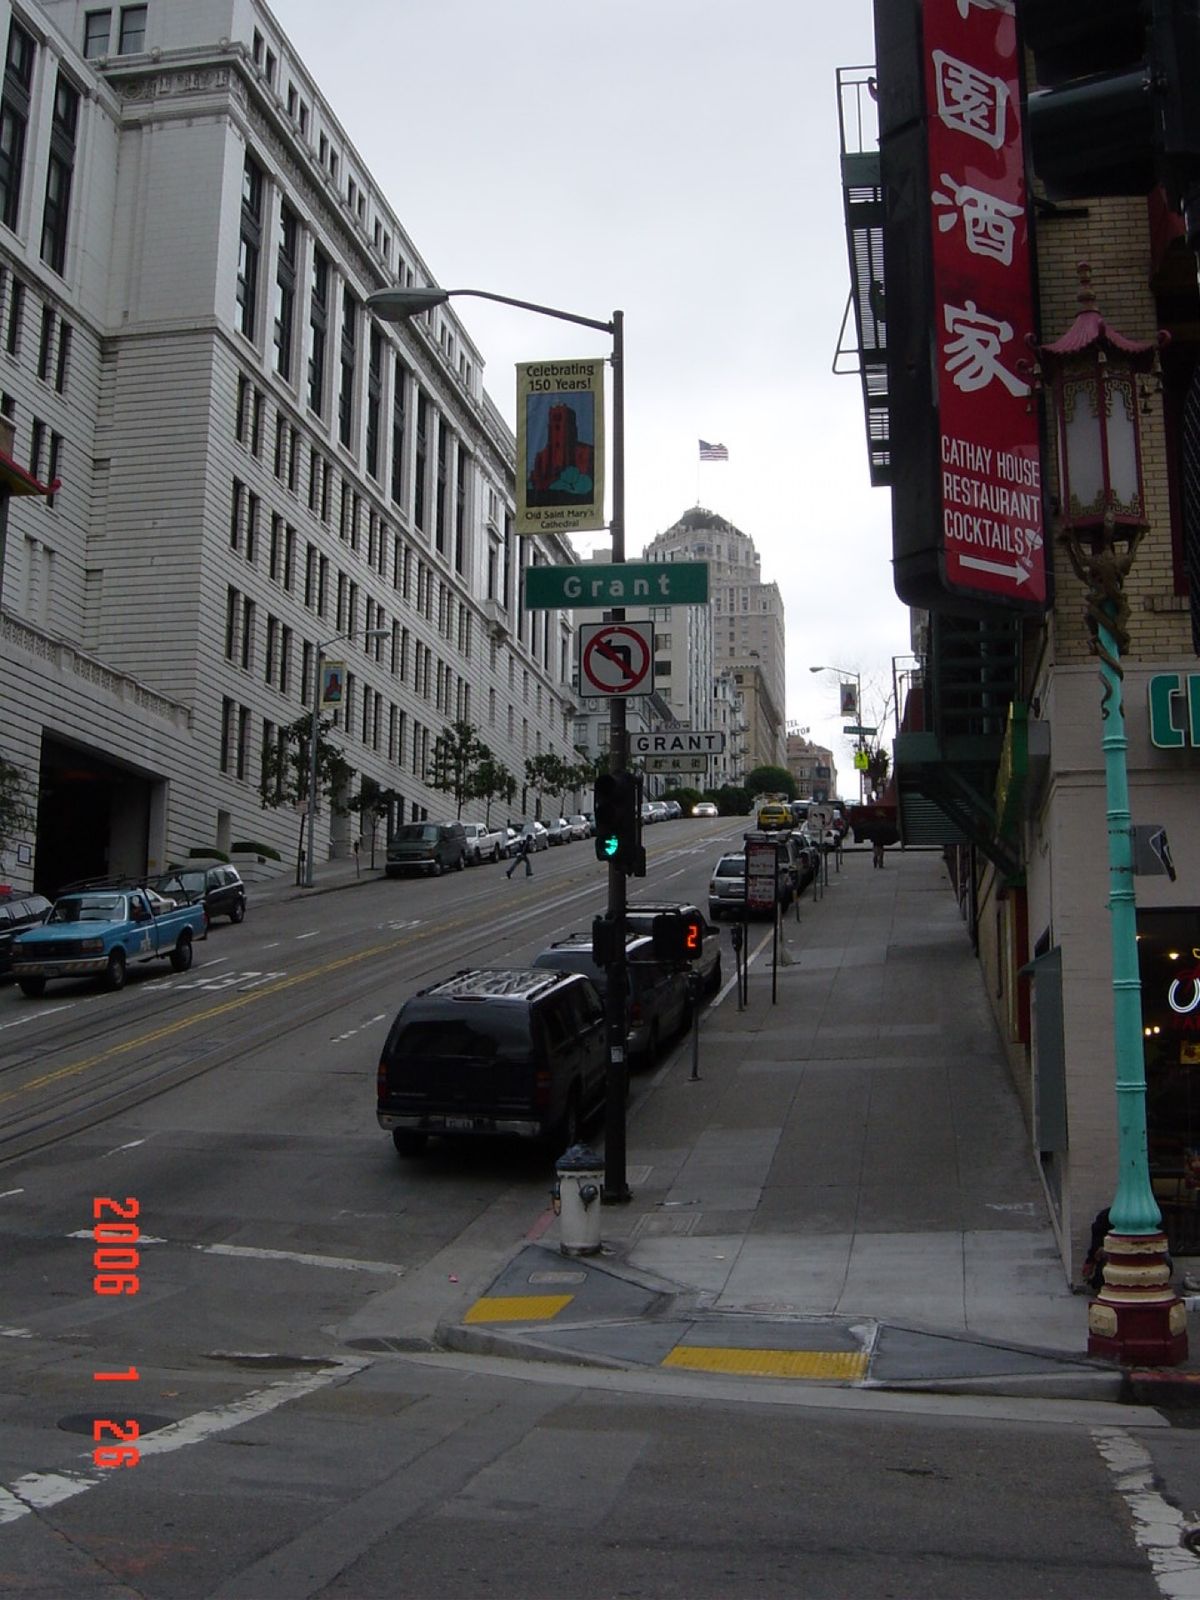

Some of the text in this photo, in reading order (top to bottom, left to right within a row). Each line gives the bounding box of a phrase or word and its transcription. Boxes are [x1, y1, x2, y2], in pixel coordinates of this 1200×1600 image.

[931, 0, 1032, 398] 園酒家
[526, 363, 594, 377] Celebrating
[529, 378, 591, 391] 150 Years!
[941, 435, 1040, 488] CATHAY HOUSE
[943, 472, 1040, 523] RESTAURANT
[525, 510, 594, 520] Old Saint Mary's
[541, 520, 579, 529] Cathedral
[944, 509, 1024, 555] COCKTAILS
[564, 574, 670, 598] Grant
[637, 735, 715, 751] GRANT
[686, 924, 697, 948] 2
